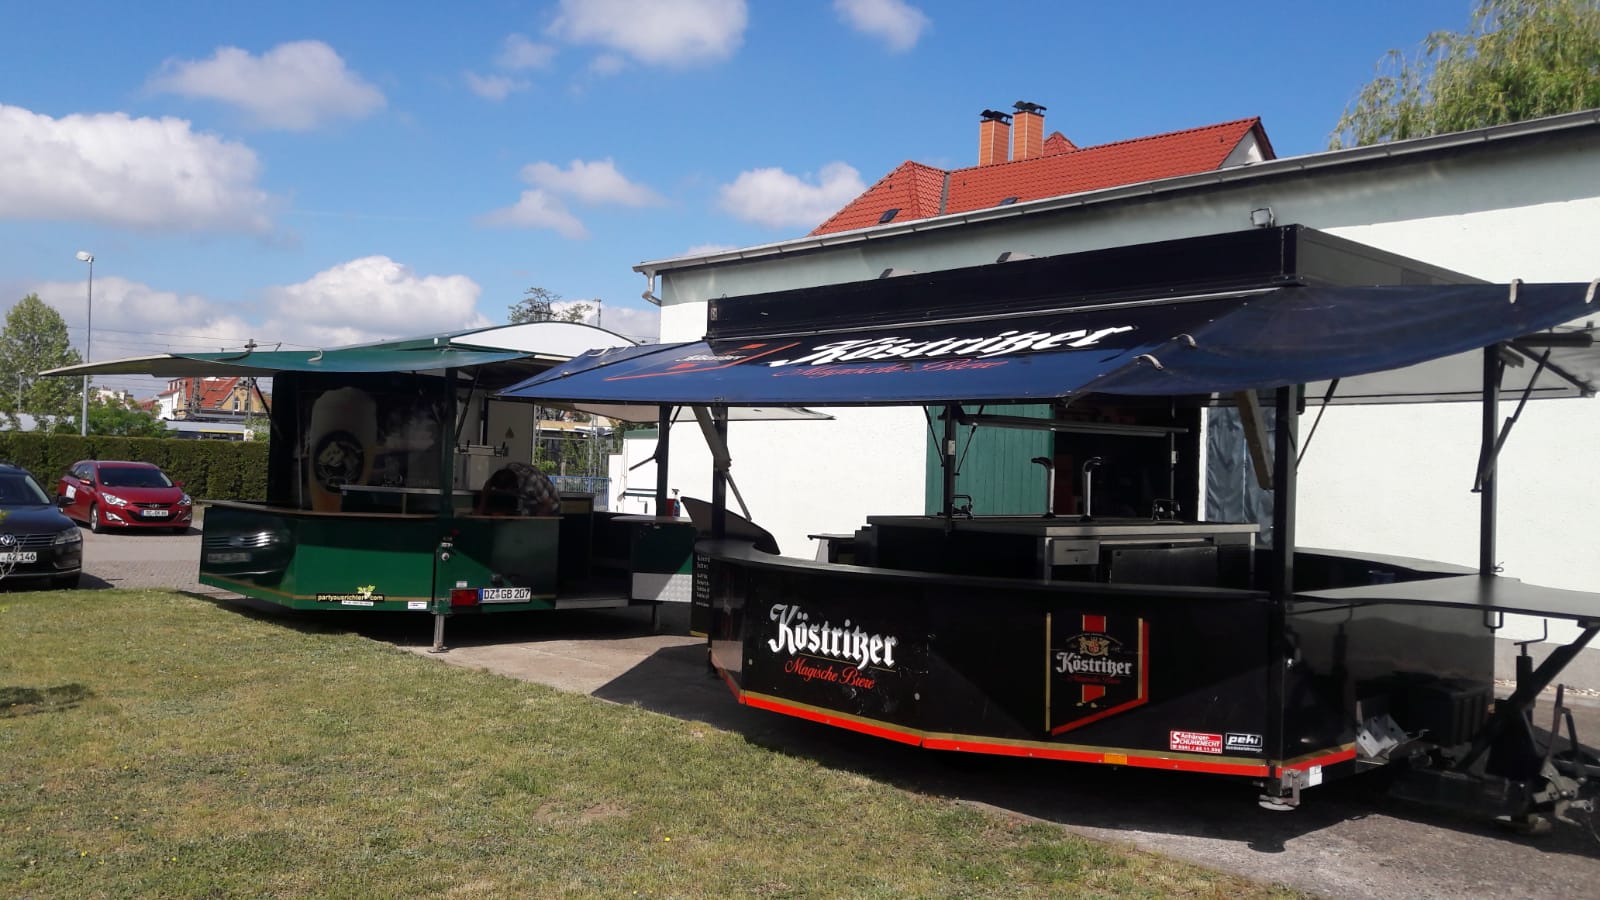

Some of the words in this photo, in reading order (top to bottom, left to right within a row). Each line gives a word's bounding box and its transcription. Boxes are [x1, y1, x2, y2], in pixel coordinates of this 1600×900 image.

[769, 325, 1133, 367] Köstritzer
[484, 590, 495, 600] DZ
[501, 590, 513, 599] GB
[514, 589, 530, 599] 207
[768, 604, 898, 670] Köstritzer
[784, 657, 838, 682] Magische
[839, 666, 876, 690] Biere
[1056, 652, 1133, 677] Köstritzer
